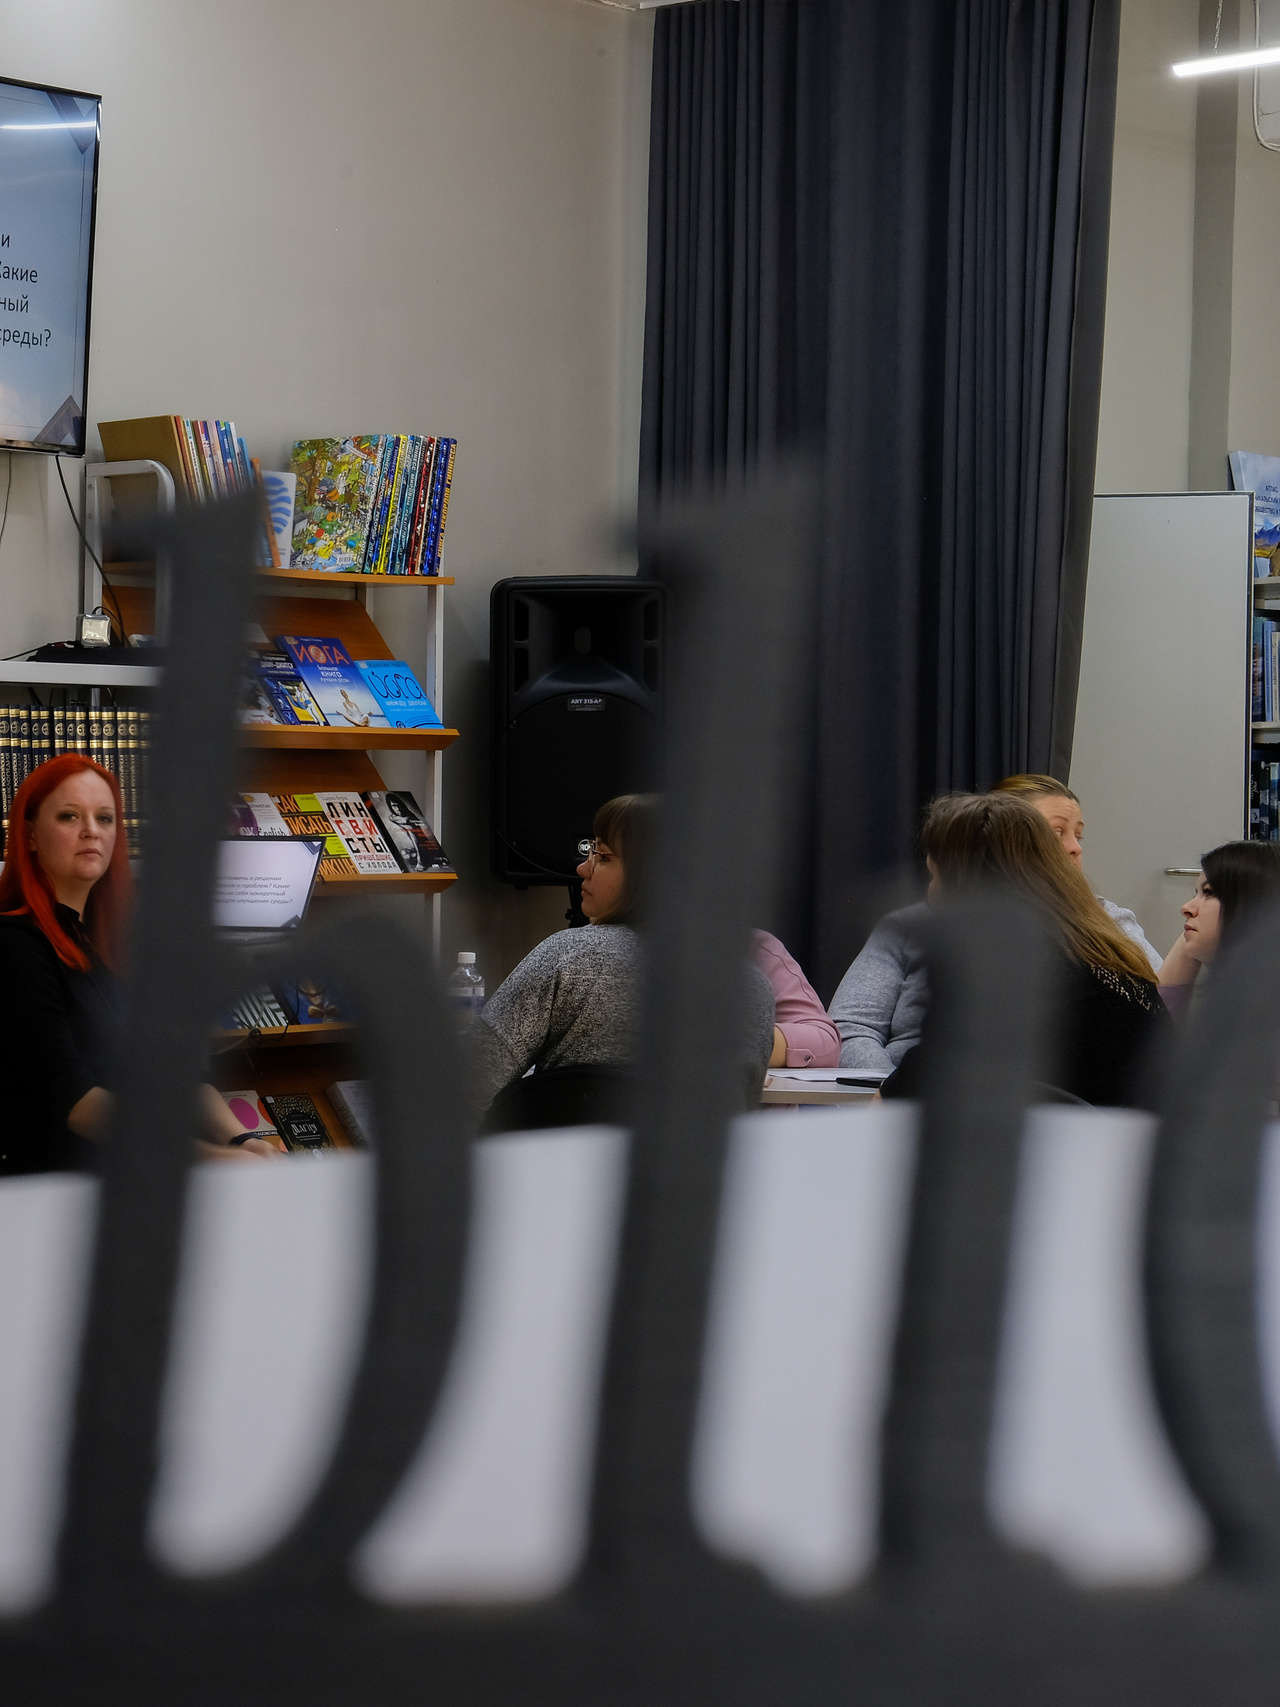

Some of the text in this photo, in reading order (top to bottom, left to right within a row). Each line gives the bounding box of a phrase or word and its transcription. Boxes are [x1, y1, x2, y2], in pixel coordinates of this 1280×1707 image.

[437, 443, 458, 559] КНИГА РЕКОРДОВ ГИННЕССА
[290, 643, 350, 665] ЙОГА
[275, 794, 302, 812] КАК
[326, 801, 370, 818] ЛИН
[283, 815, 334, 836] ПИСАТЬ
[334, 819, 379, 836] ГВИ
[344, 837, 389, 854] СТЫ
